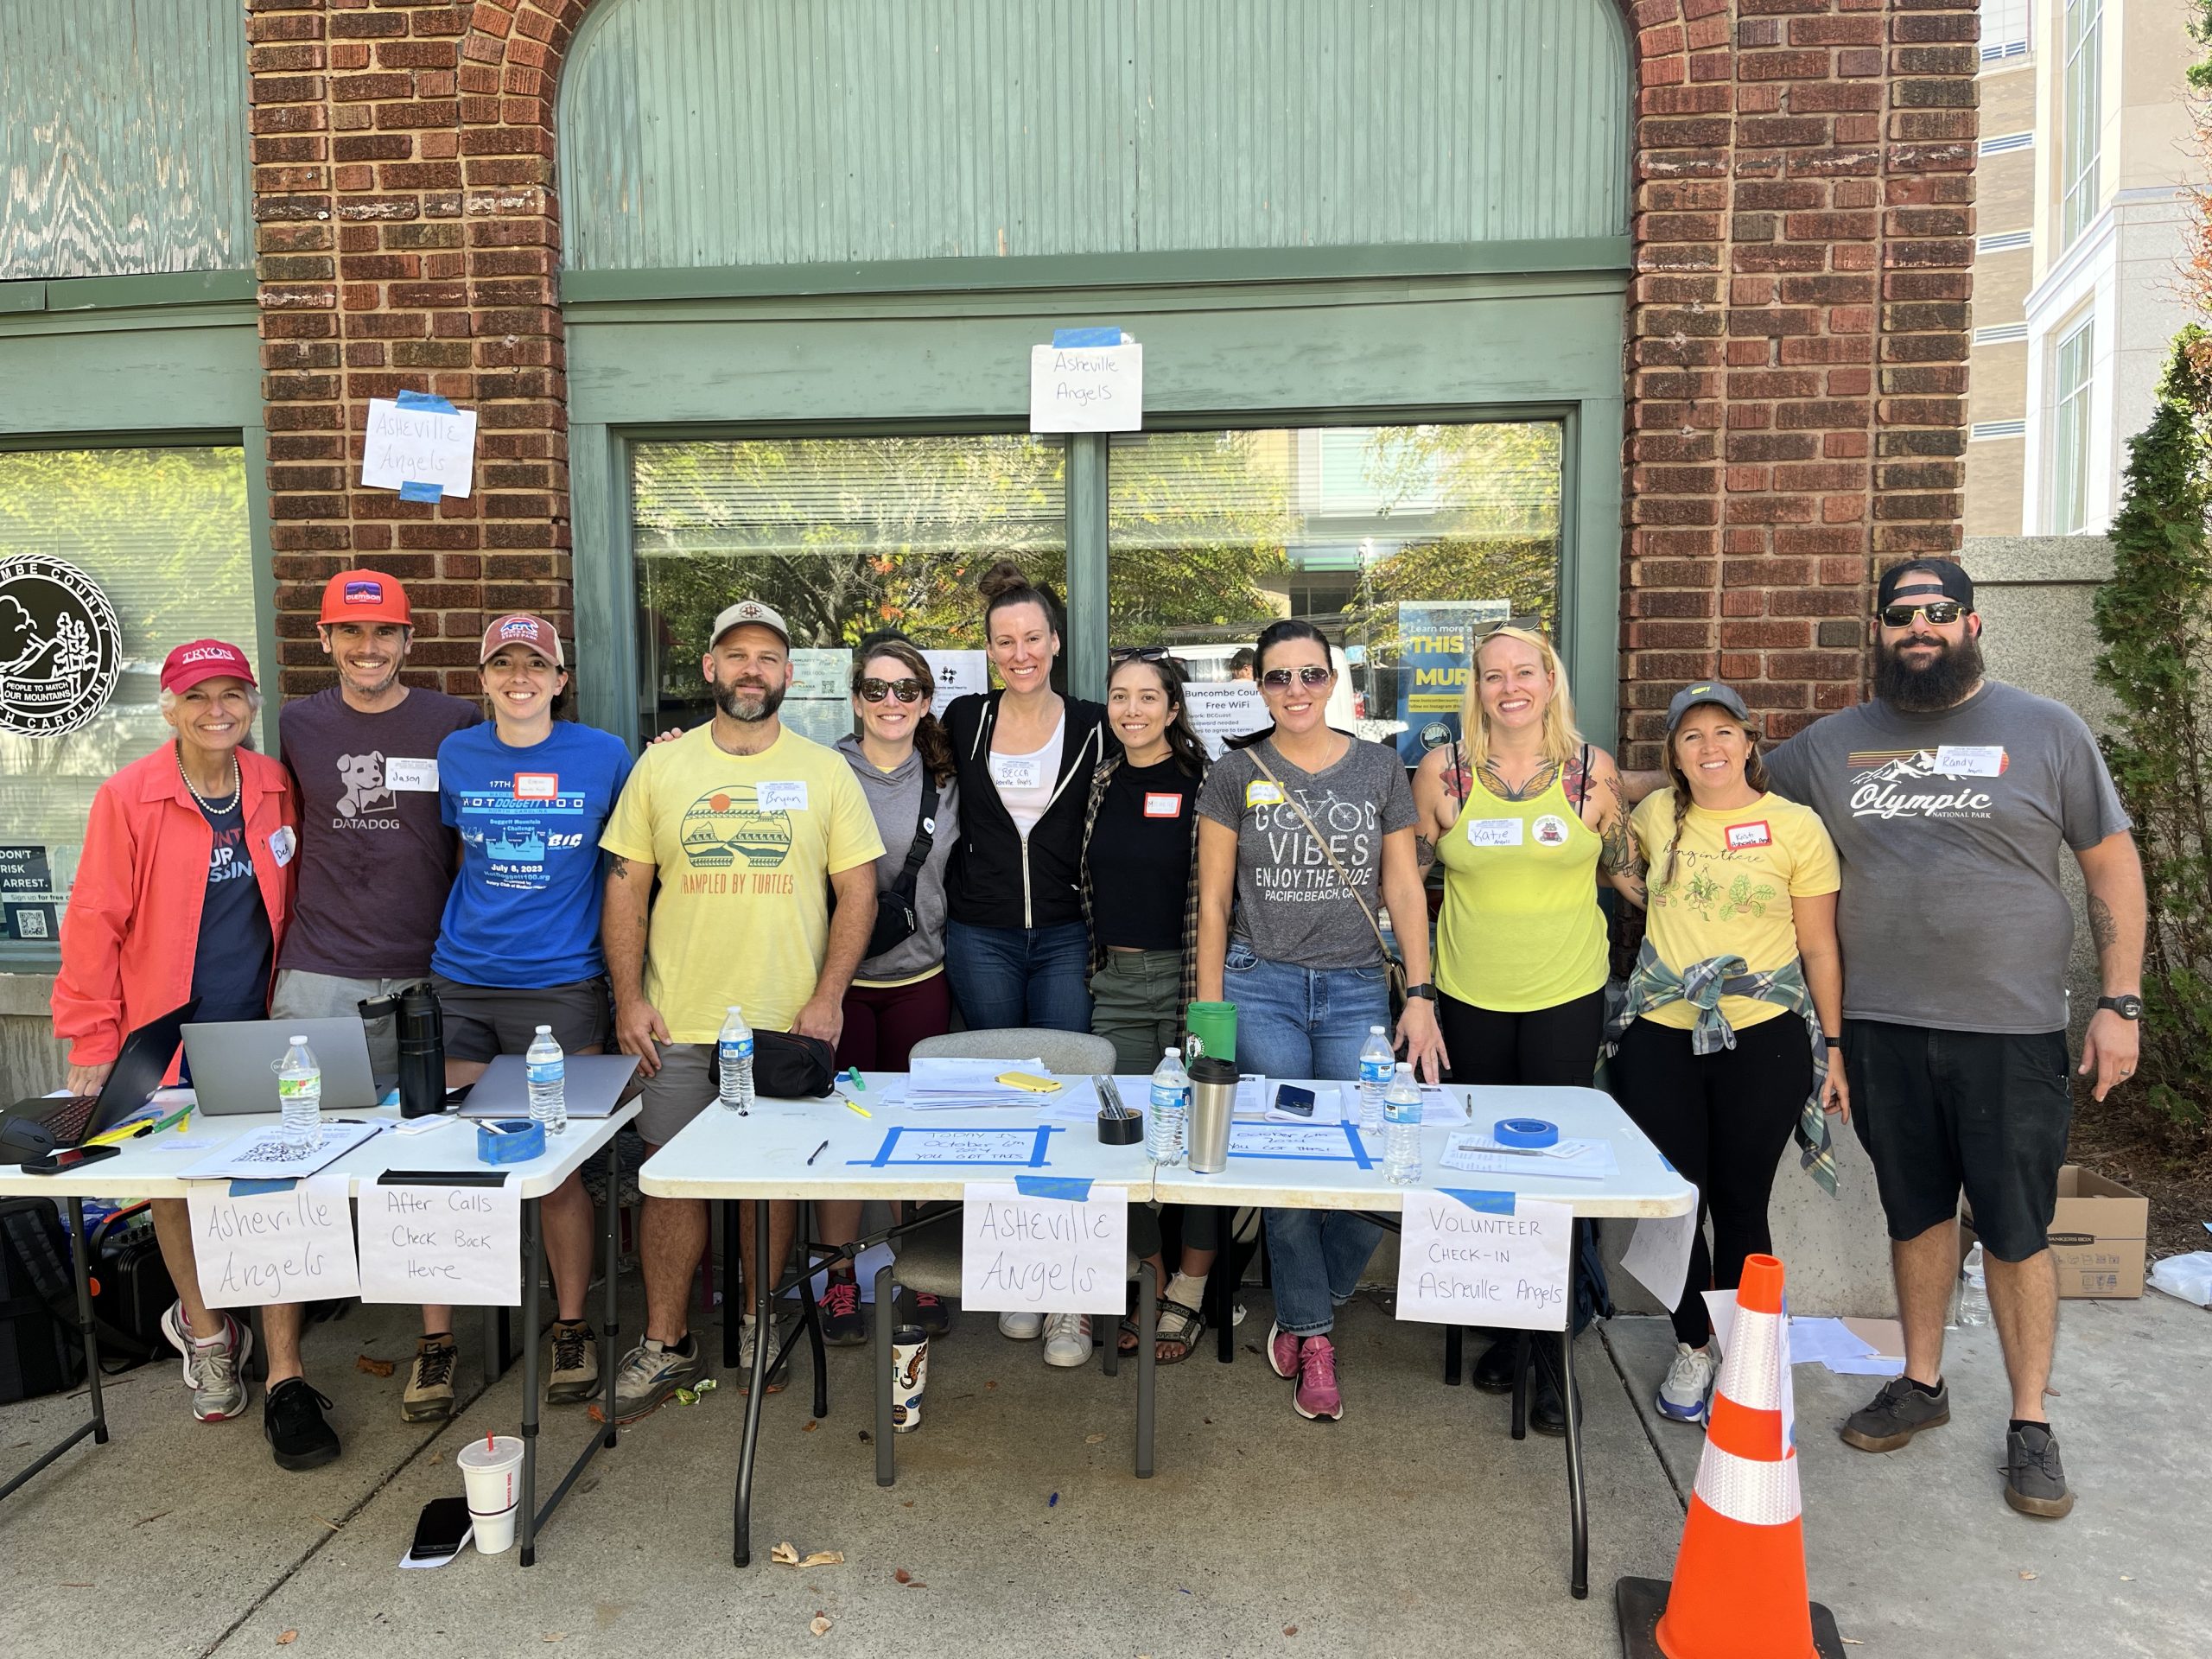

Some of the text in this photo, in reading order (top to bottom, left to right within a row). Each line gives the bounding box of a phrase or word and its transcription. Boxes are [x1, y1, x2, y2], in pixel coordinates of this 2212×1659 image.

[1053, 351, 1120, 372] Asheville
[1056, 381, 1112, 407] Angels
[379, 443, 447, 480] Angels
[50, 568, 110, 632] COUNTY
[1412, 635, 1465, 654] THIS
[182, 647, 236, 664] TRYON
[4, 690, 72, 702] OUR MOUNTAINS
[6, 682, 33, 691] PEOPLE
[46, 681, 69, 690] MATCH
[28, 671, 110, 729] CAROLINA
[392, 772, 420, 785] Jason
[1002, 767, 1029, 779] BECCA
[495, 798, 543, 808] DOGGETT
[766, 791, 802, 806] Bryan
[1850, 784, 1993, 819] Olympic
[333, 818, 400, 830] DATADOG
[1474, 829, 1509, 842] Katie
[1268, 831, 1370, 866] VIBES
[1663, 839, 1699, 868] hng
[1, 864, 25, 874] RISK
[491, 864, 508, 873] July
[1255, 868, 1302, 889] ENJOY
[1306, 868, 1336, 889] THE
[3, 879, 48, 888] ARREST.
[732, 873, 747, 894] BY
[753, 873, 794, 895] TURTLES
[1265, 887, 1355, 902] PACIFIC BEACH, CA
[388, 1190, 493, 1214] After Calls
[208, 1191, 332, 1242] Asheville
[1428, 1207, 1542, 1236] VOLUNTEER
[392, 1224, 492, 1249] Check Back
[1428, 1243, 1510, 1263] CHECK-IN
[219, 1241, 324, 1299] Angels
[408, 1259, 462, 1280] Here
[1418, 1272, 1563, 1310] Asheville Angels
